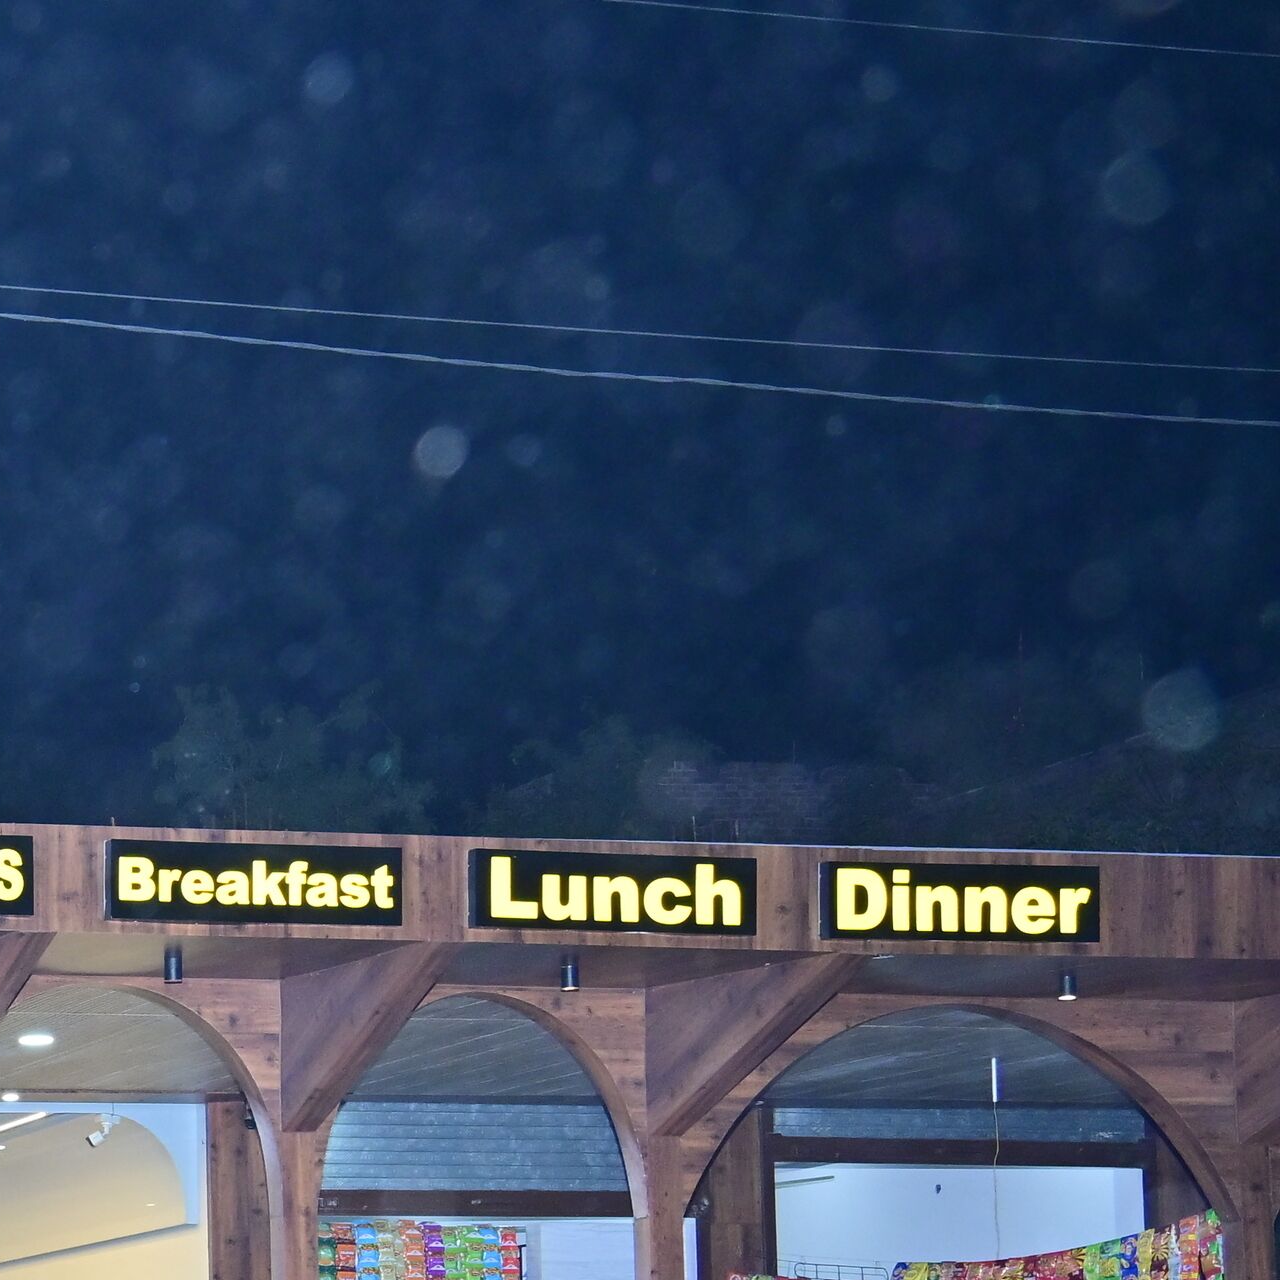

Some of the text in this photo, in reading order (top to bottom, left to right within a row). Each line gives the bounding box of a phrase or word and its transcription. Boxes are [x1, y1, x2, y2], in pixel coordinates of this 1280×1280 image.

[117, 856, 394, 909] Breakfast
[489, 855, 742, 926] Lunch
[835, 866, 1091, 935] Dinner
